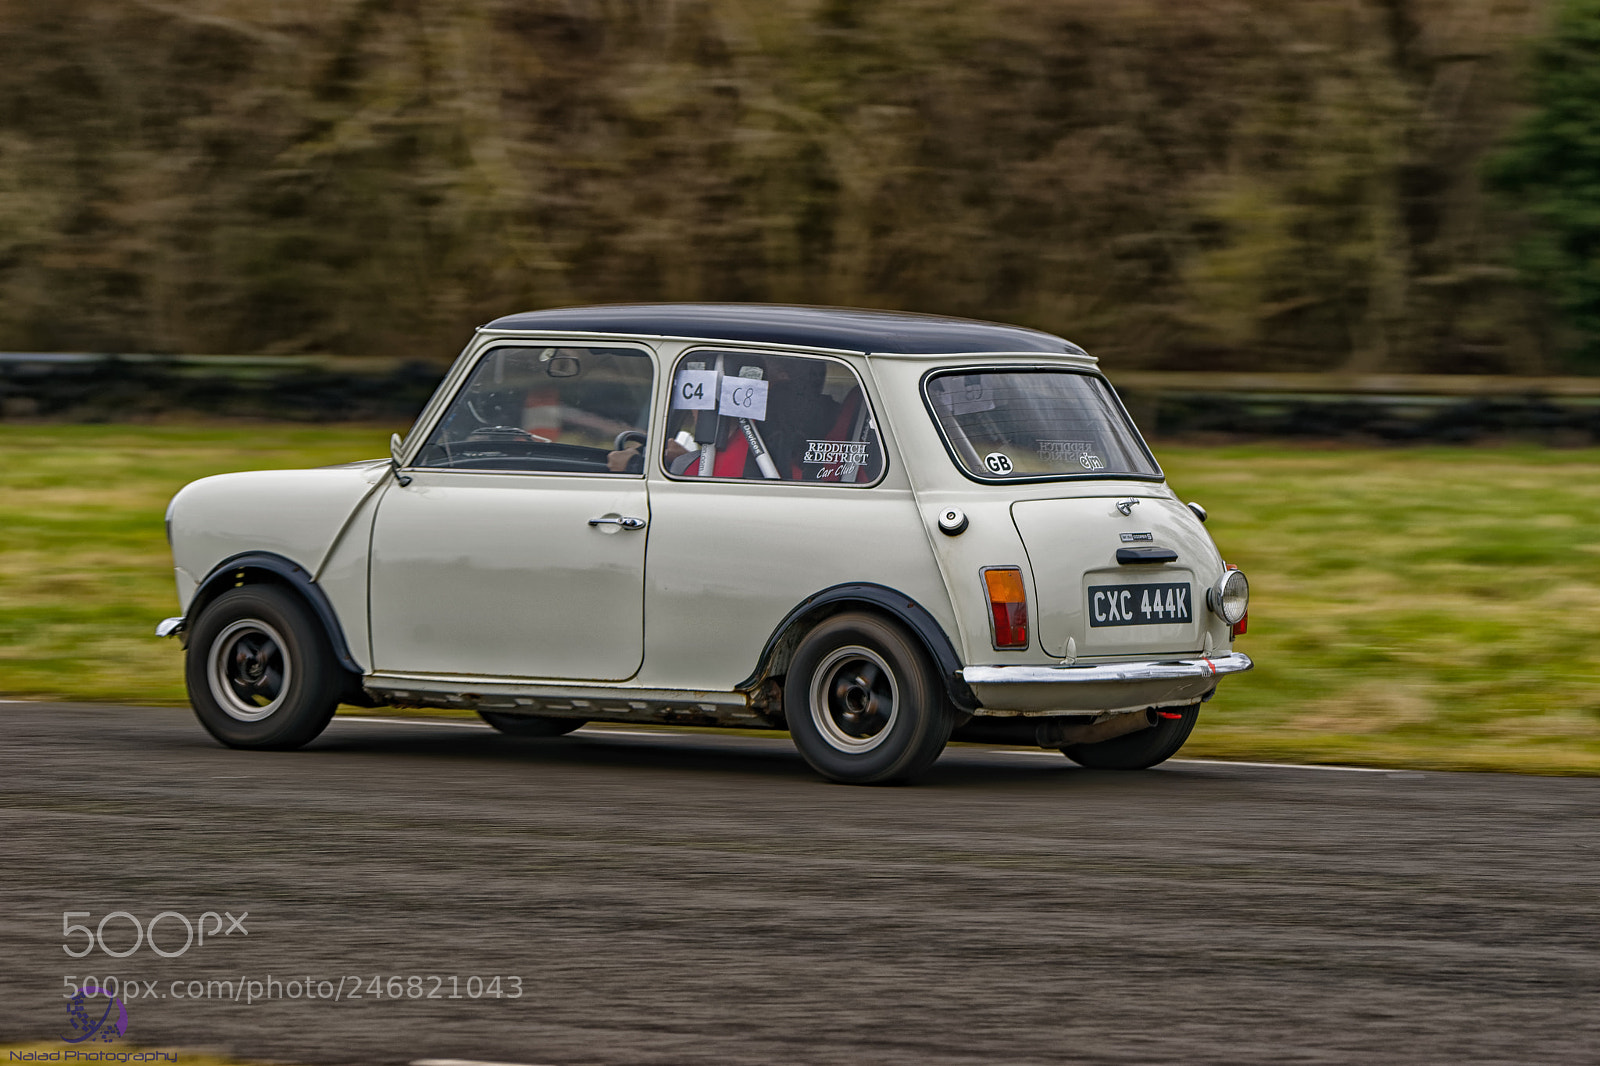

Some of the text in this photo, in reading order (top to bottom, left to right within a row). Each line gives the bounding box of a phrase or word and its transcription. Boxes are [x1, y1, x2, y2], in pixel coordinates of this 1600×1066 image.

[682, 382, 704, 400] C4
[732, 387, 754, 408] C8
[743, 424, 763, 454] Devices
[808, 442, 867, 454] REDDITCH
[814, 451, 869, 464] DISTRICT
[986, 456, 1012, 472] GB
[816, 463, 855, 479] Car Club
[1093, 588, 1188, 622] CXC 444K
